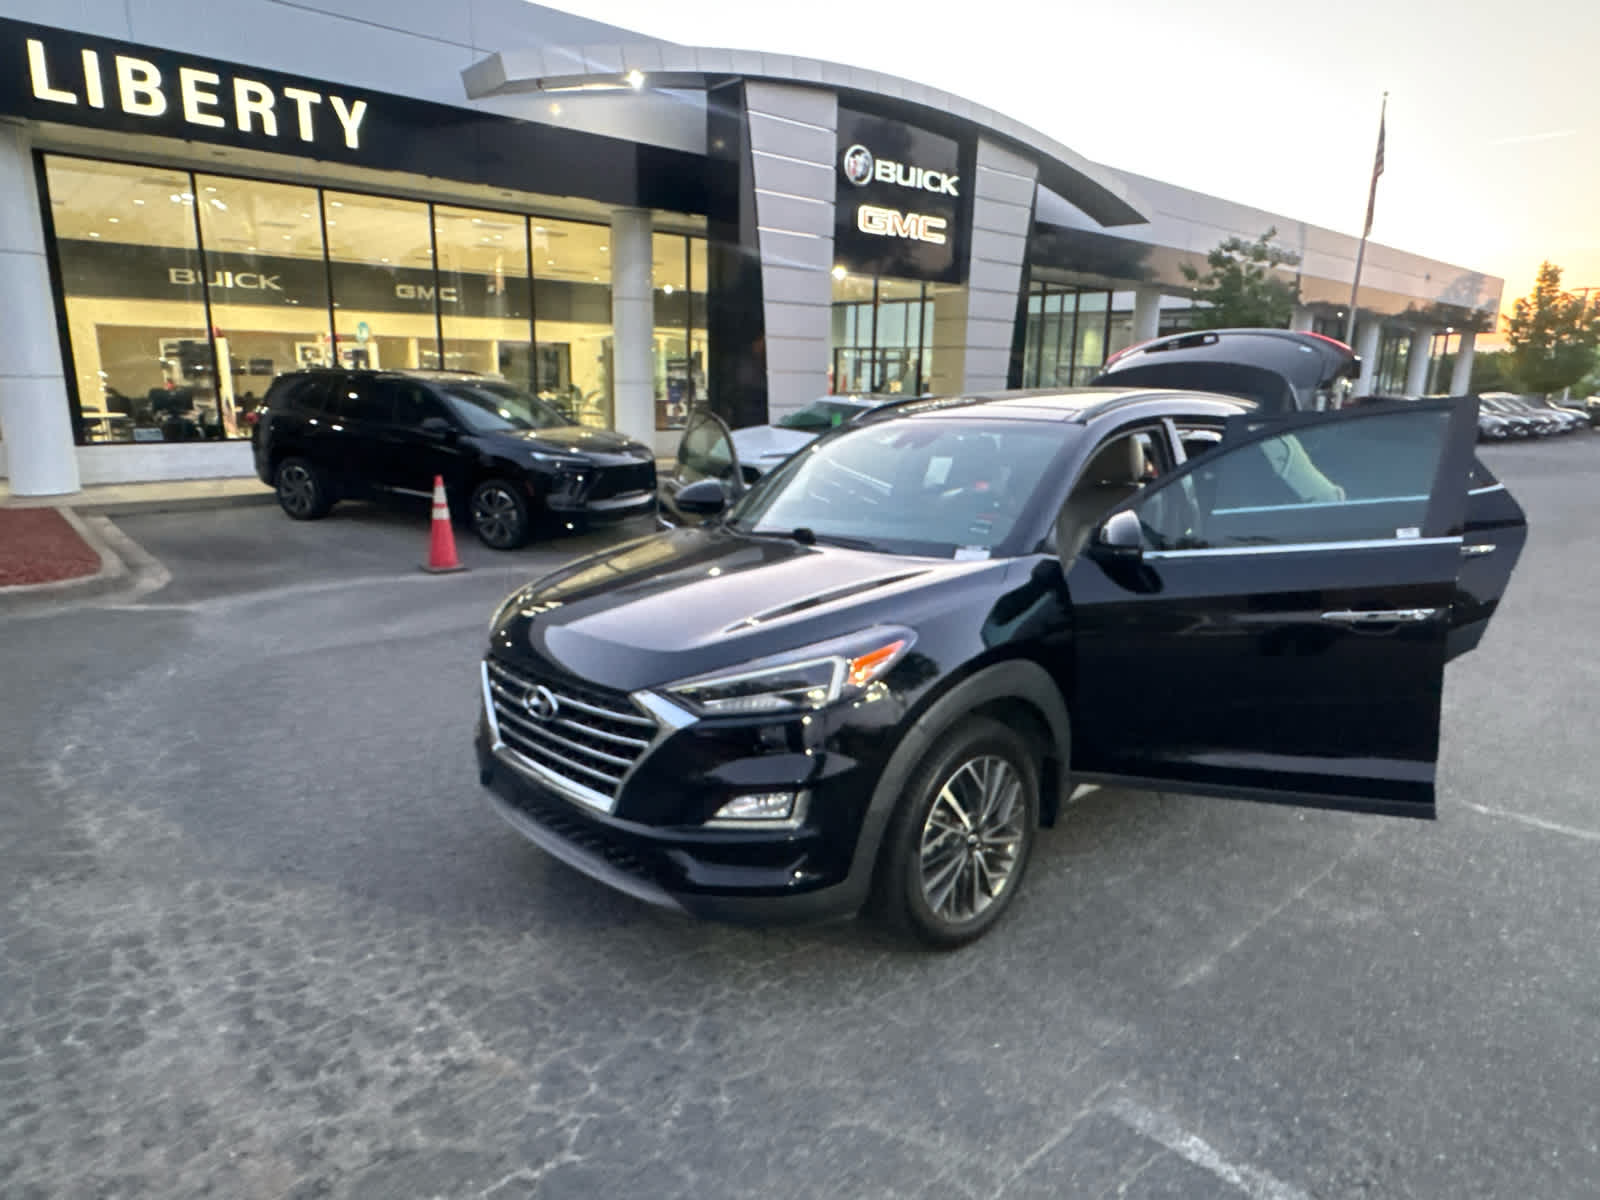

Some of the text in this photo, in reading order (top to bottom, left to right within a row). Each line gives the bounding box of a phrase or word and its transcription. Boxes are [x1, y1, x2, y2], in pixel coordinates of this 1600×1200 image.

[26, 38, 368, 149] LIBERTY
[874, 159, 960, 196] BUICK
[857, 204, 947, 244] GMC
[168, 267, 282, 291] BUICK
[395, 283, 458, 302] GMC
